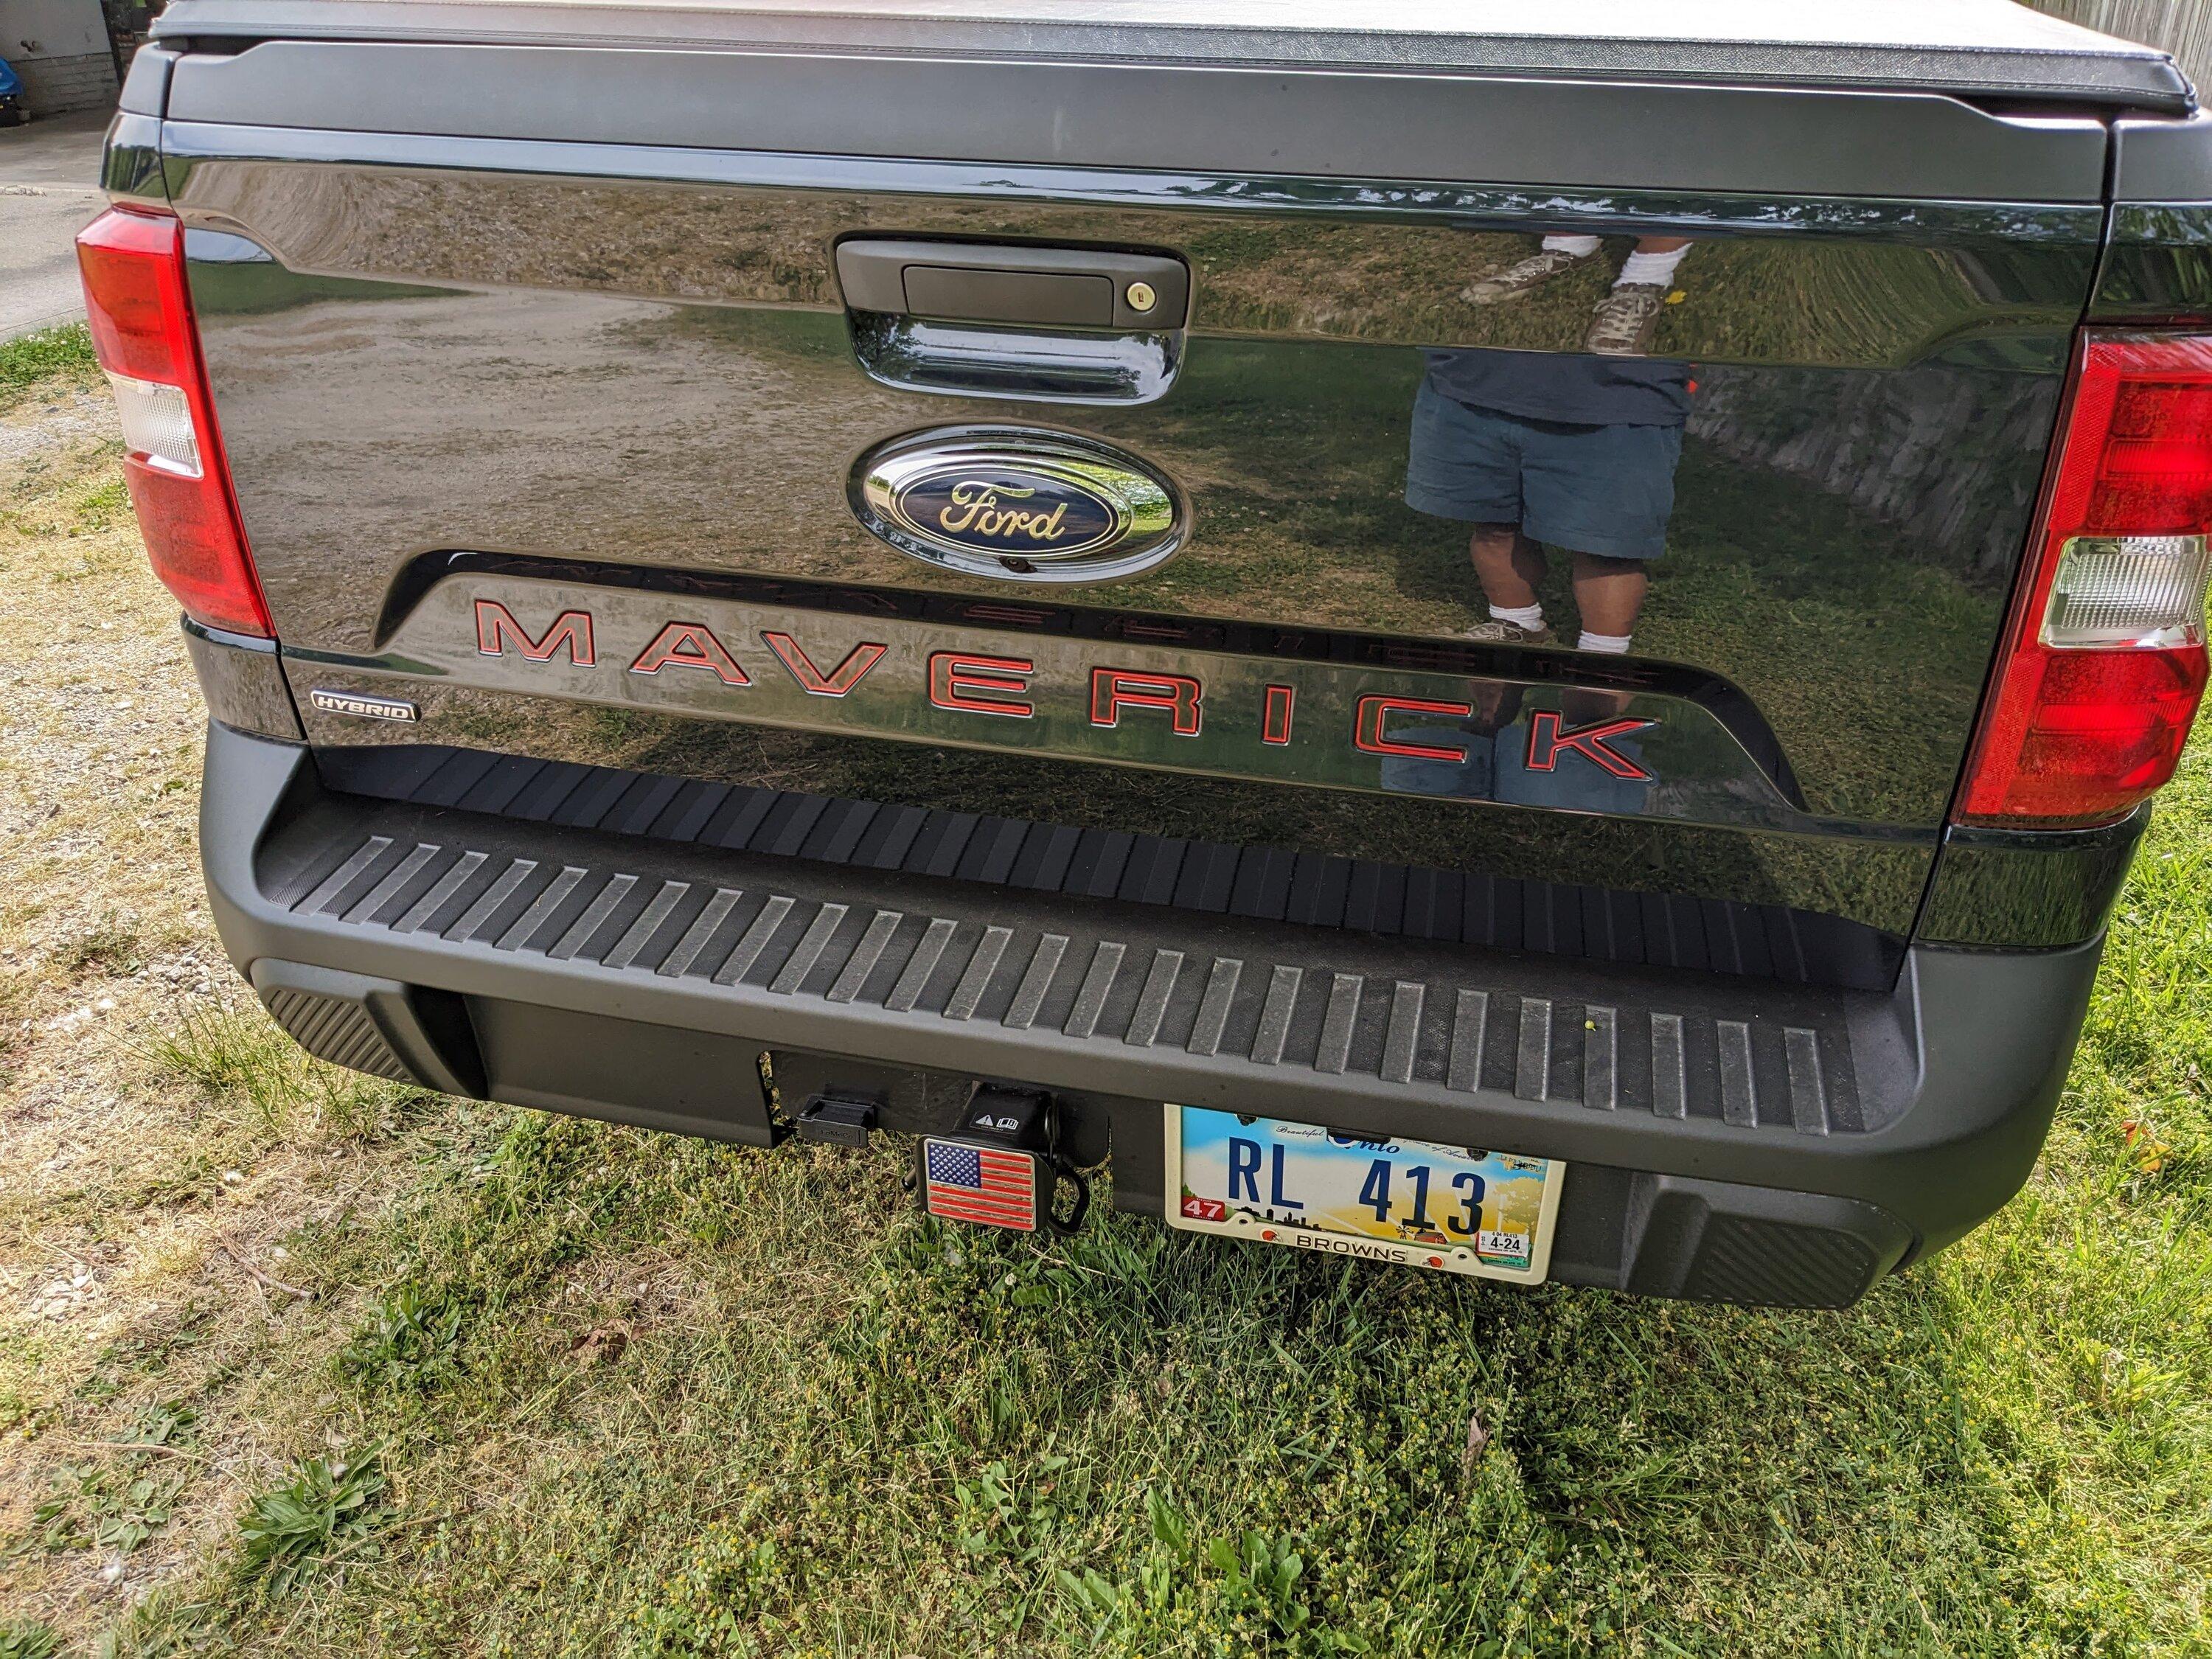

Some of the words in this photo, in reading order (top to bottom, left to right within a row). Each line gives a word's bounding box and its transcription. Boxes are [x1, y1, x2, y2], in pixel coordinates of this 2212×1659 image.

[940, 480, 1068, 541] Ford
[474, 598, 1660, 782] MAVERICK
[317, 696, 408, 719] HYBRID
[1276, 1125, 1325, 1138] Beautiful
[1228, 1136, 1304, 1210] RL
[1359, 1158, 1486, 1235] 413
[1184, 1200, 1222, 1218] 47
[1297, 1234, 1406, 1262] BROWNS
[1490, 1237, 1520, 1251] 4-24
